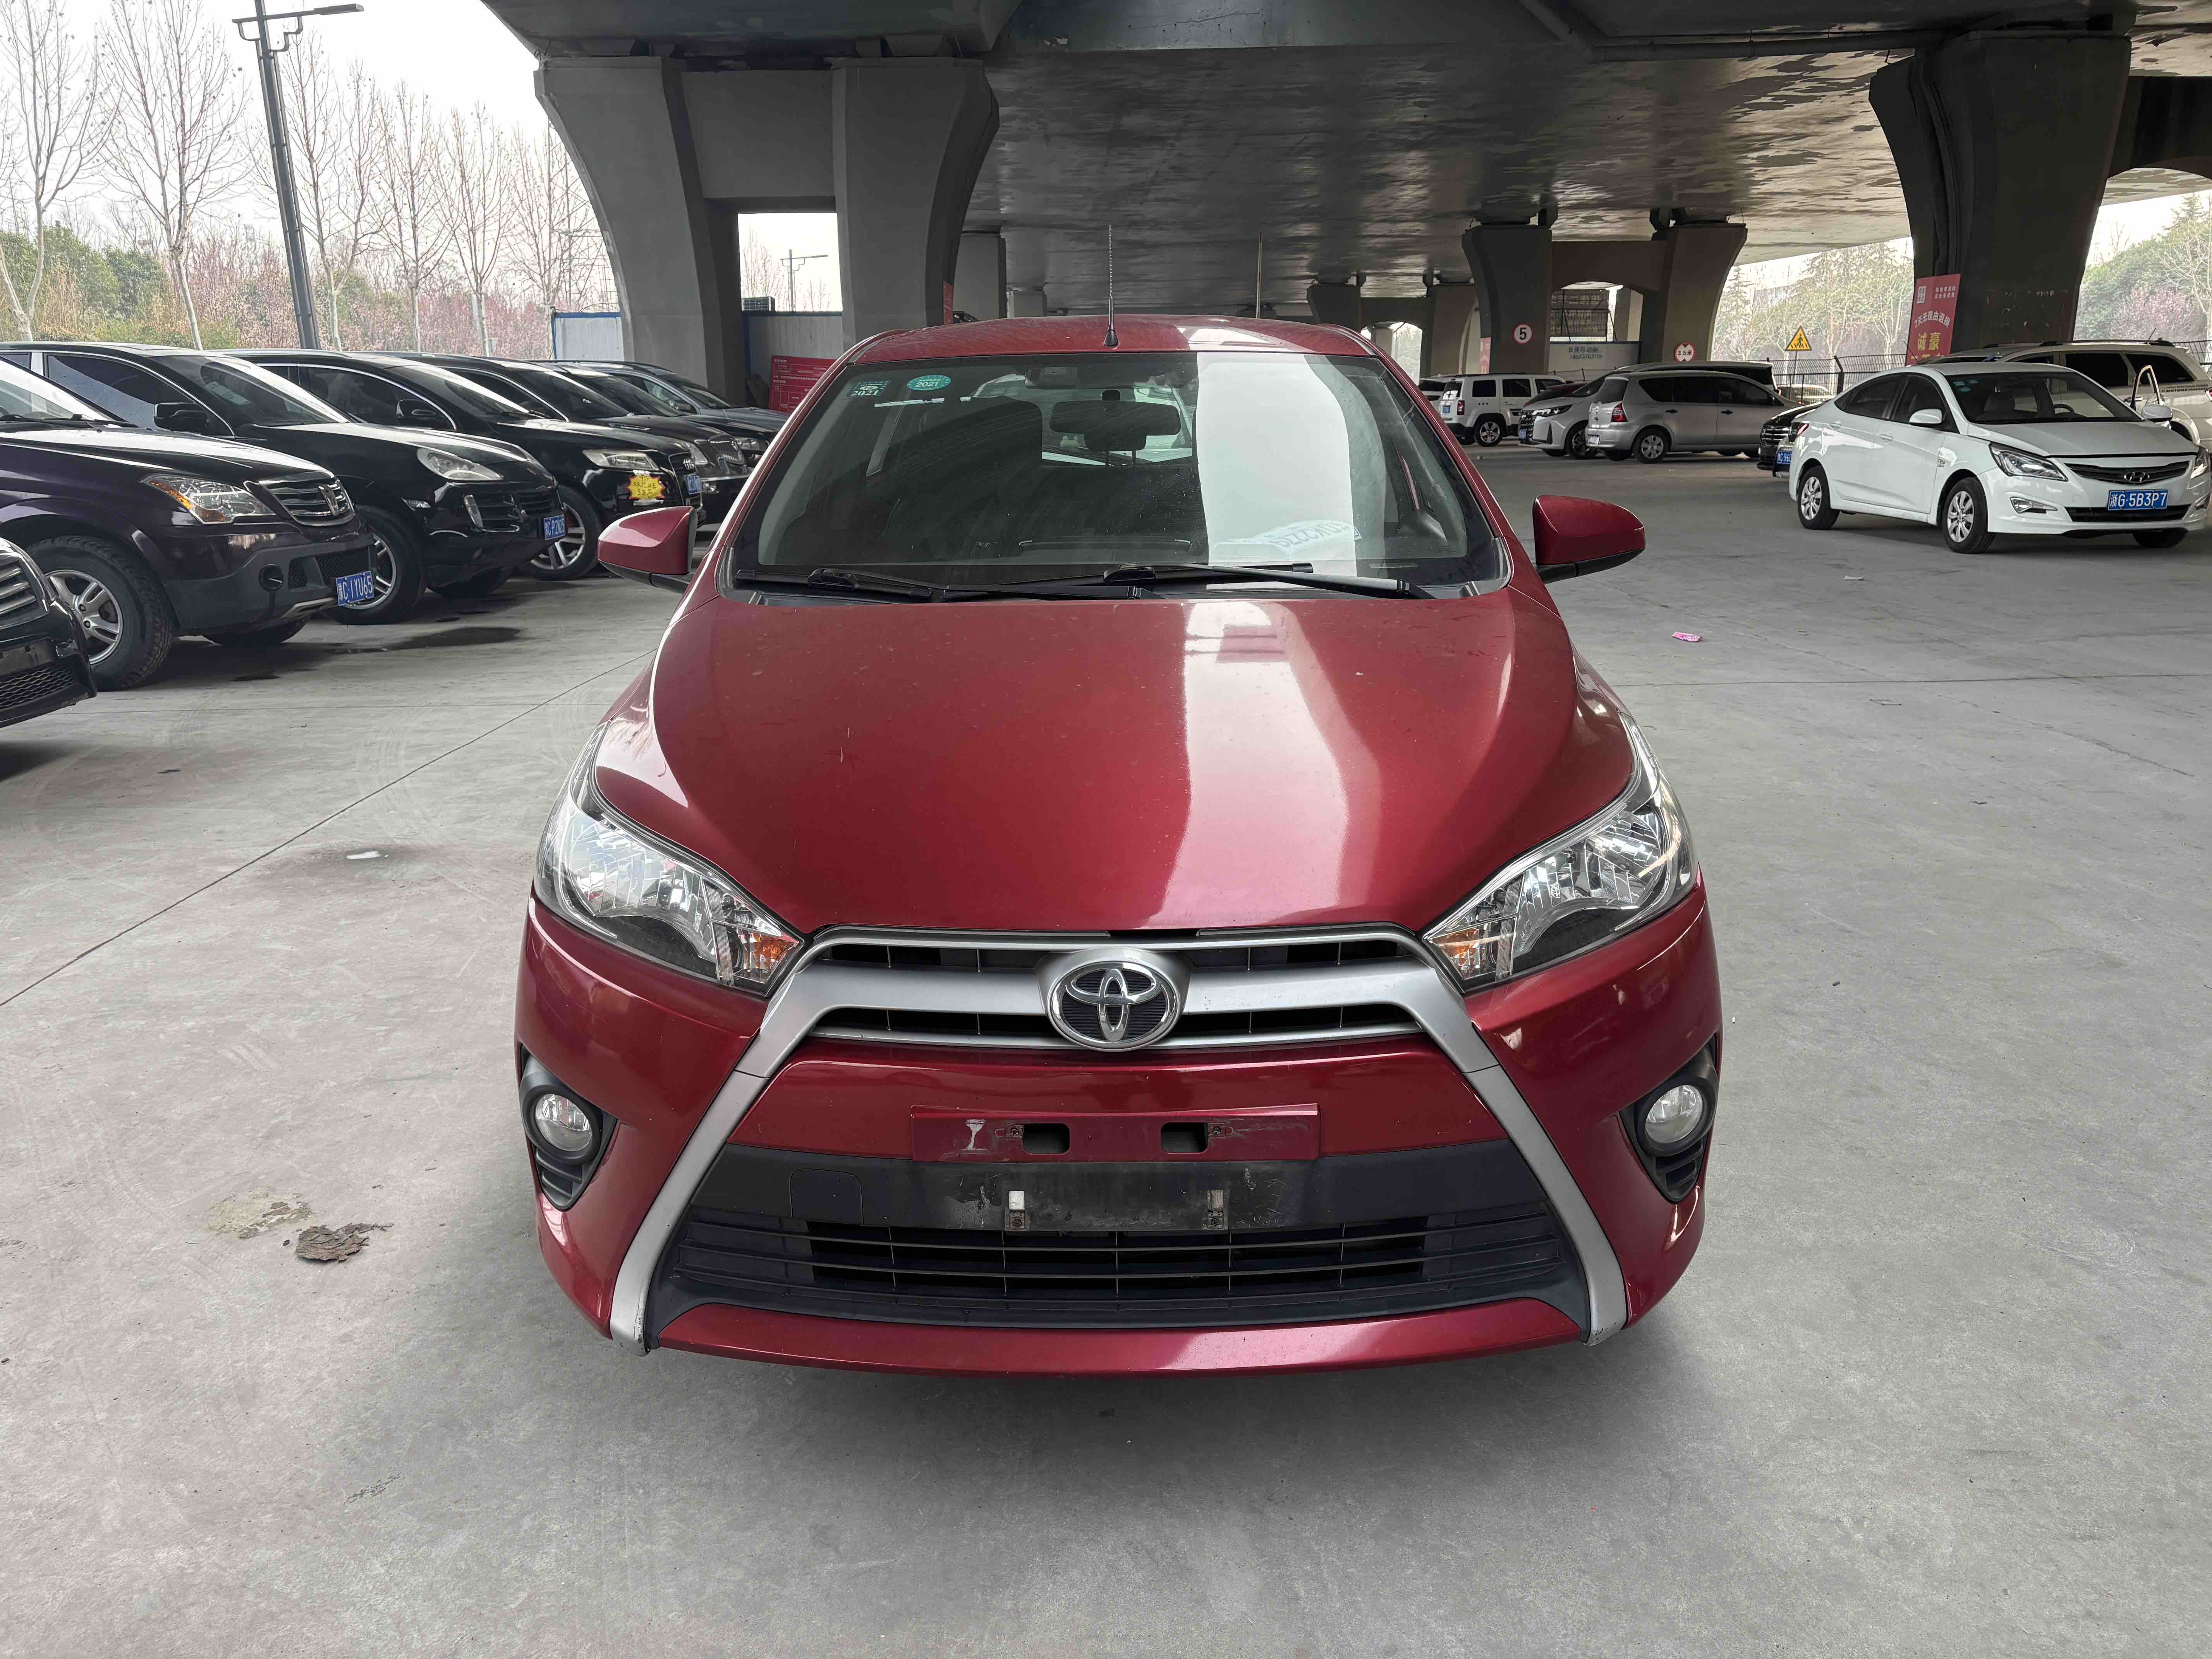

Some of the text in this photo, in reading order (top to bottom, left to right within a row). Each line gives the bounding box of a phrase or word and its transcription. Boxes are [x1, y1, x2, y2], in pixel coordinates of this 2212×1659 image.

[1520, 327, 1527, 340] 5
[1917, 332, 1941, 350] 诚豪
[2110, 492, 2167, 508] 浙G·5B3P7
